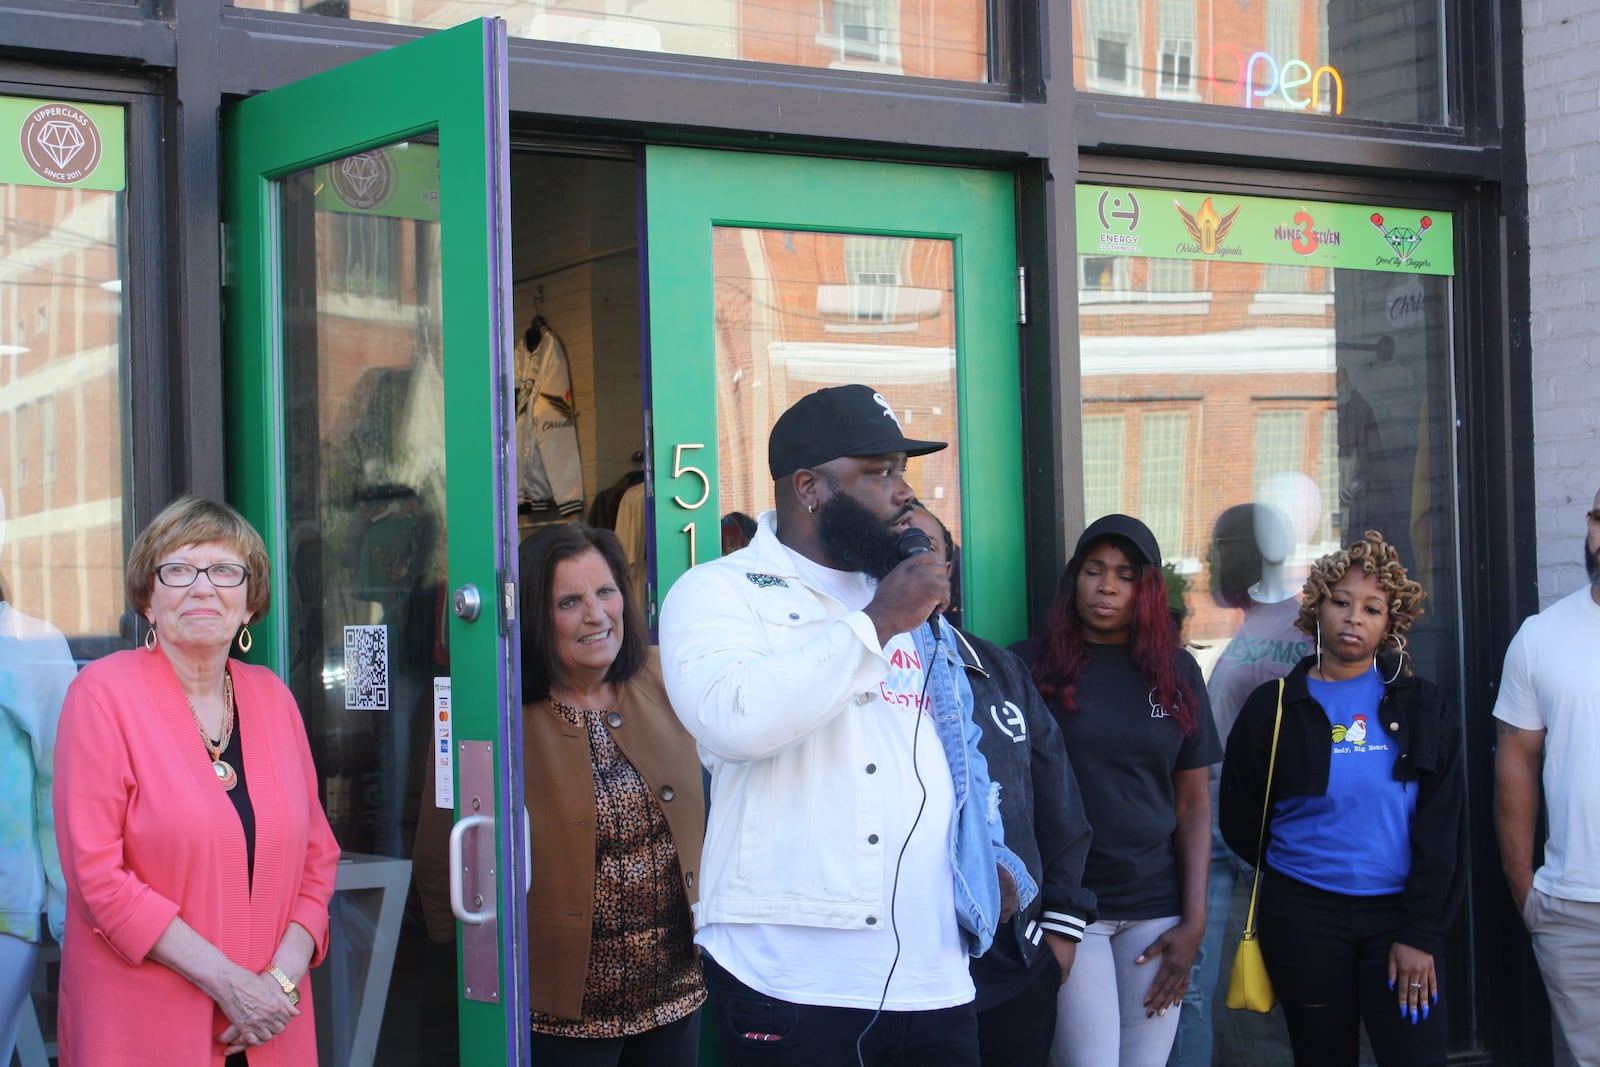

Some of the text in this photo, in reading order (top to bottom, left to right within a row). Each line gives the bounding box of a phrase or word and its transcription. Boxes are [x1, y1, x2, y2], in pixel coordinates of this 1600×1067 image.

[33, 108, 88, 126] UPPERCLASS
[43, 167, 82, 180] SINCE 2011
[1100, 234, 1138, 244] ENERGY
[1292, 211, 1319, 255] 3
